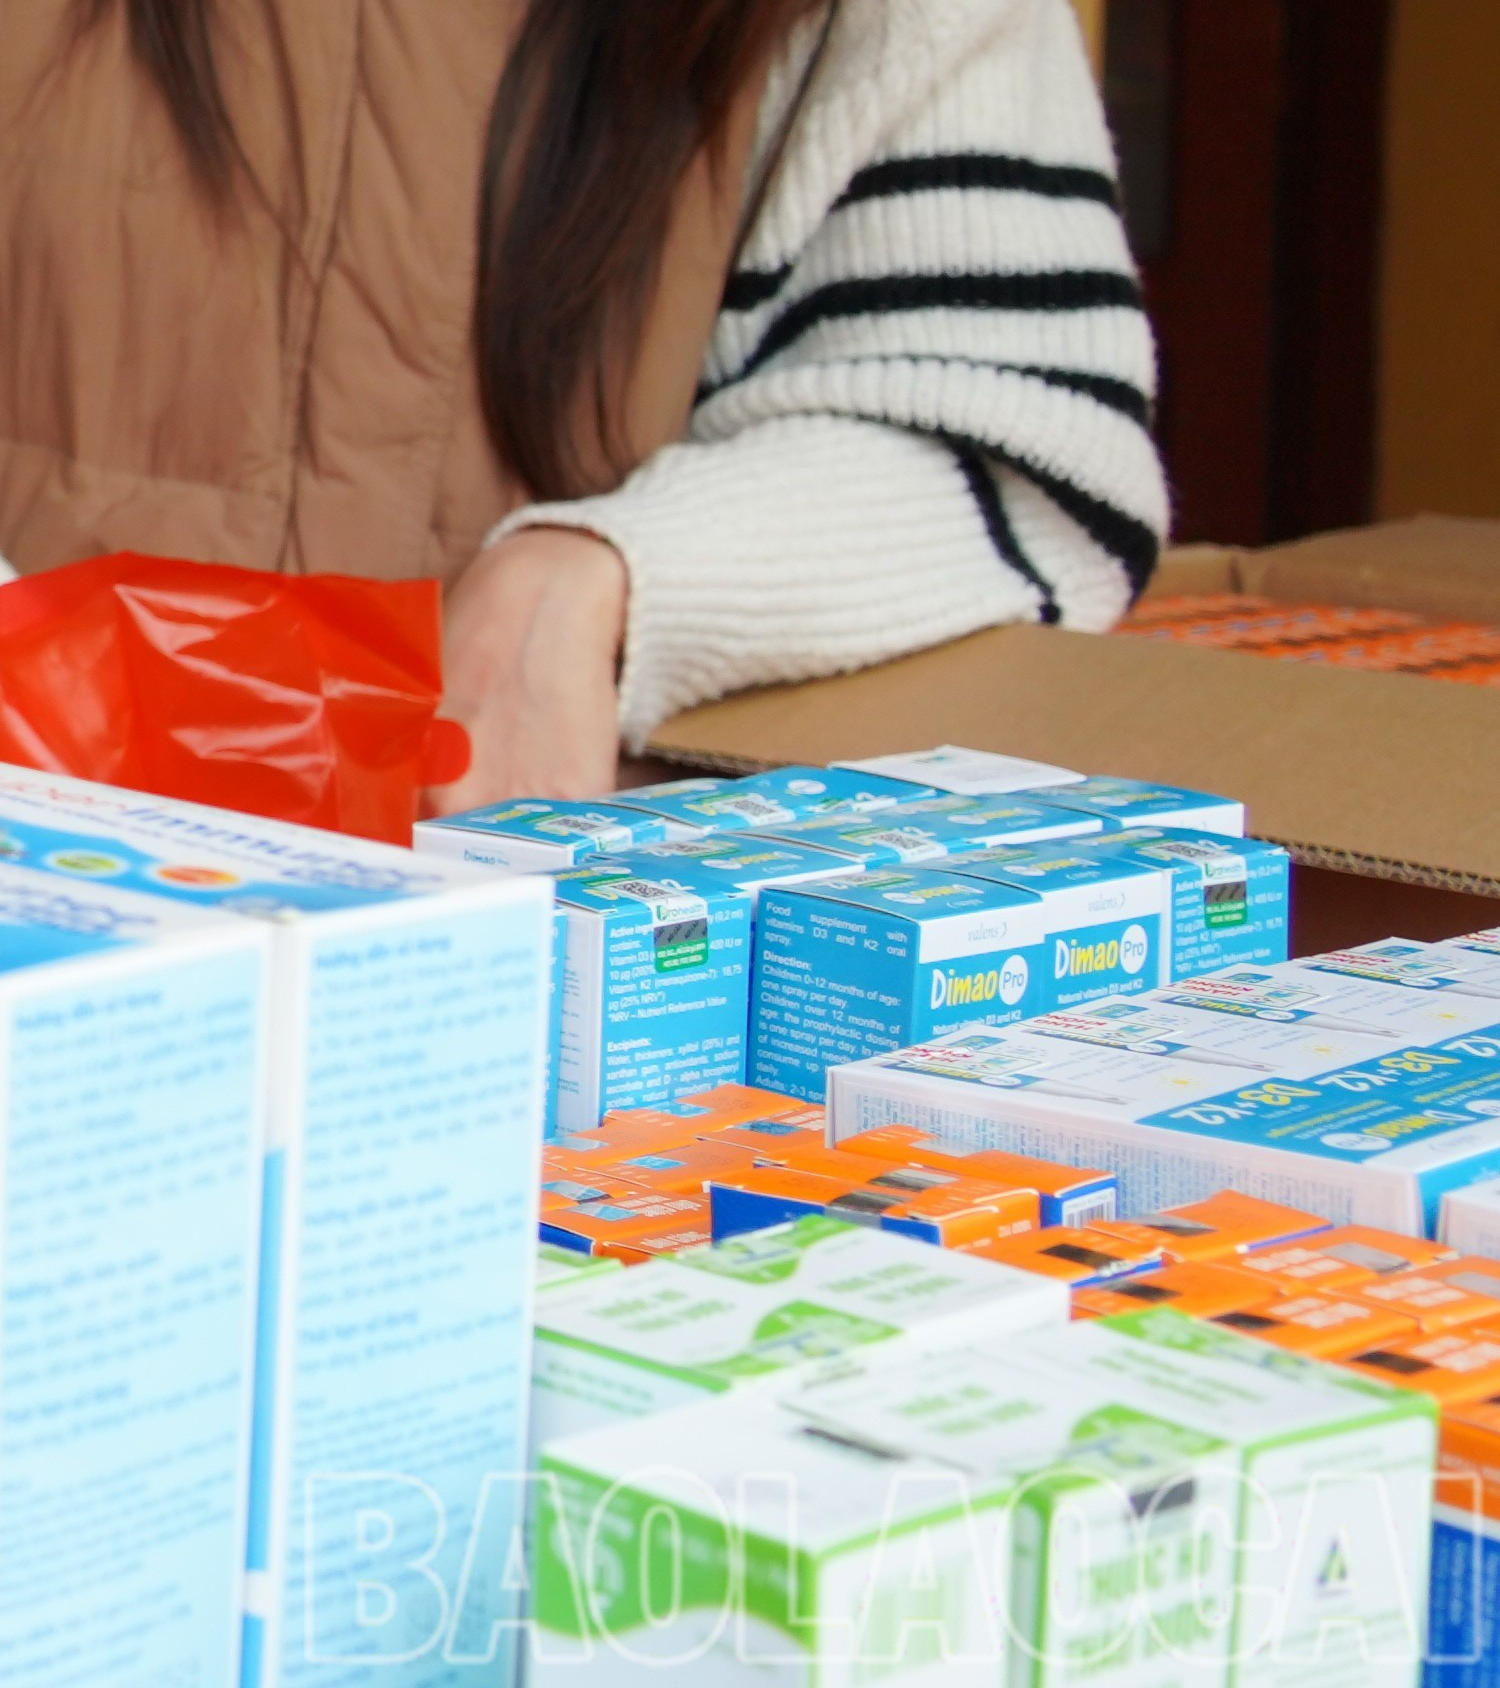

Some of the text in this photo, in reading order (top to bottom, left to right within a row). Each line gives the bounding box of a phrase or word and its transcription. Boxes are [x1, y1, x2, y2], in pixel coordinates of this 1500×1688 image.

[764, 917, 907, 957] vitamins D3 and K2 oral
[765, 902, 908, 944] Food supplement with
[764, 931, 792, 947] spray.
[762, 949, 813, 971] Direction:
[1054, 938, 1145, 980] Dimao Pro
[761, 964, 802, 984] Children
[803, 974, 827, 989] 0-12
[827, 980, 866, 999] months
[866, 990, 879, 1002] of
[761, 980, 849, 1010] one spray per day.
[930, 967, 1025, 1010] Dimao Pro
[1057, 978, 1144, 1005] Natural vitamin D3 and K2
[760, 991, 901, 1036] Children over 12 months of
[985, 1013, 997, 1026] D3
[996, 1012, 1011, 1025] and
[1010, 1009, 1022, 1021] K2
[758, 1021, 768, 1032] is
[769, 1023, 788, 1037] one
[789, 1028, 817, 1044] spray
[818, 1034, 837, 1048] per
[783, 1011, 800, 1025] the
[803, 1016, 863, 1041] prophylactic
[865, 1032, 900, 1049] dosing
[757, 1033, 819, 1057] of increased
[756, 1047, 819, 1074] consume up
[756, 1061, 781, 1077] daily.
